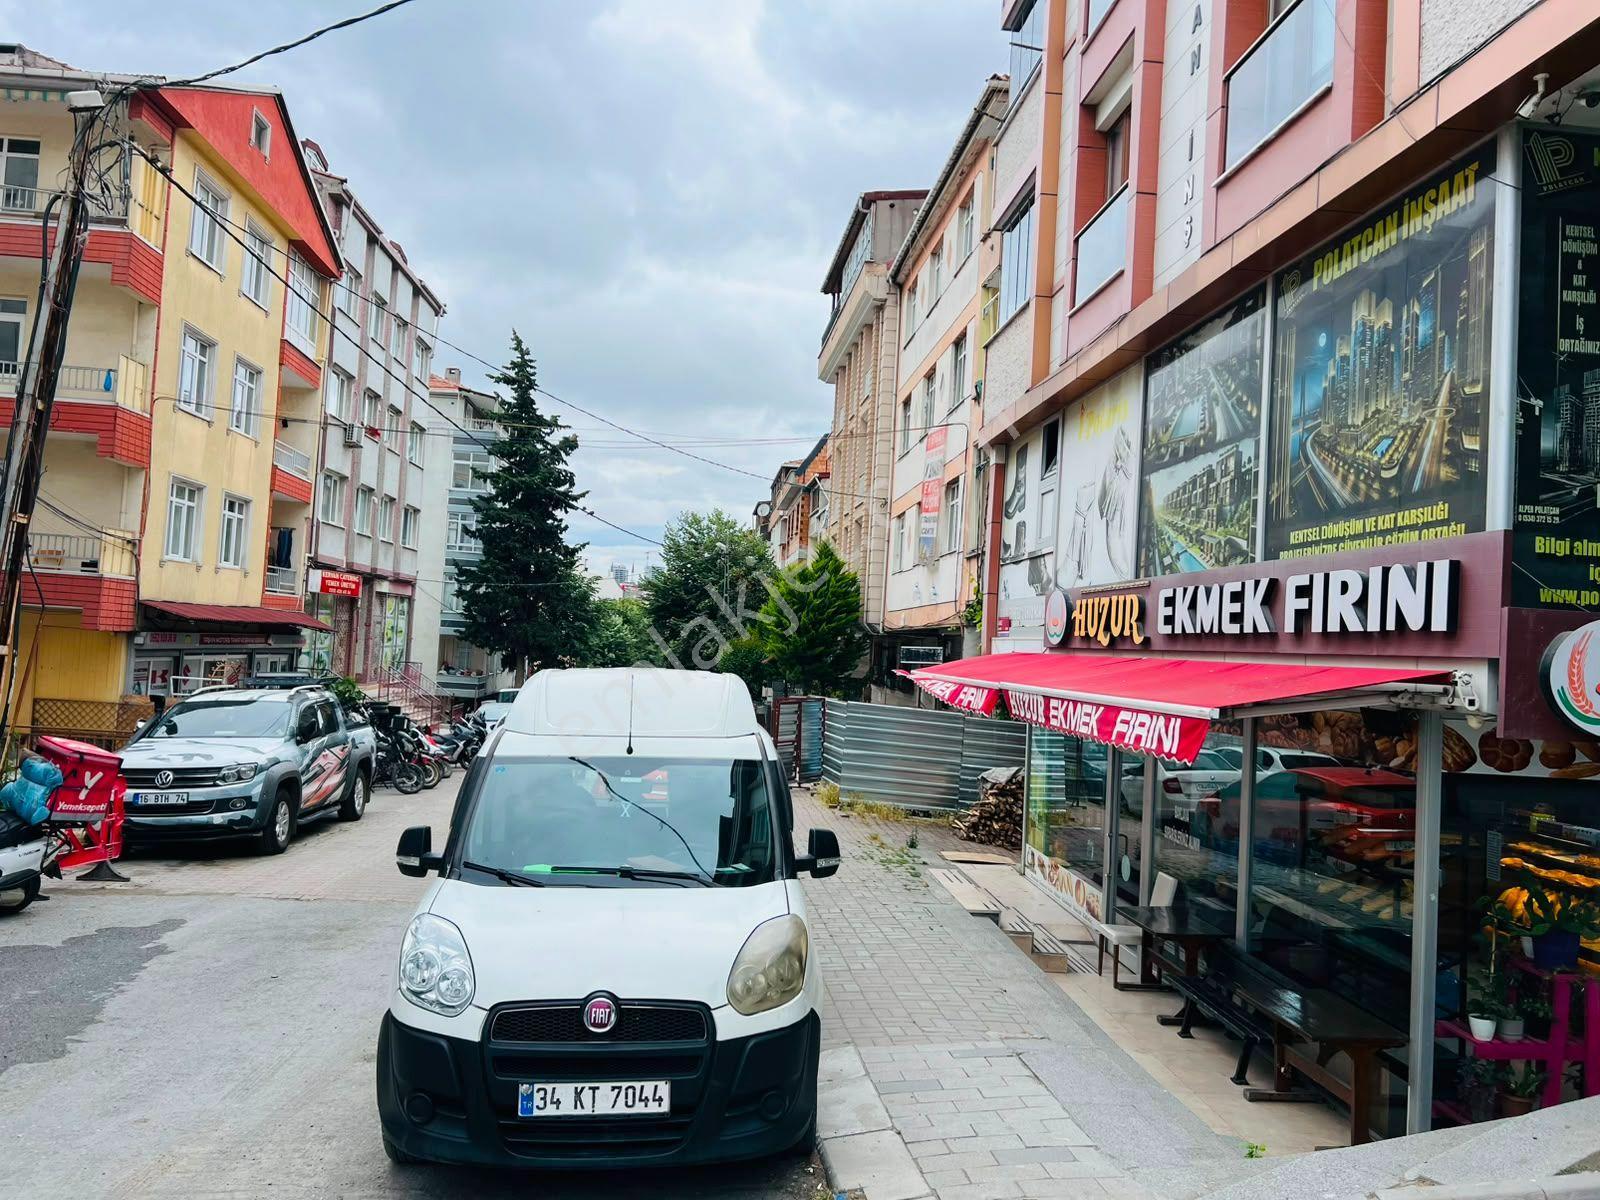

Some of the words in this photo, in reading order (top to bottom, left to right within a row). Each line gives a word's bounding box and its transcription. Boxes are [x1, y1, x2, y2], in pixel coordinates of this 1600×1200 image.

[1312, 210, 1398, 292] POLATCAN
[1401, 161, 1479, 240] İNŞAAT
[1565, 224, 1595, 238] KENTSEL
[1562, 240, 1598, 258] DÖNÜŞÜM
[1573, 274, 1587, 287] KAT
[1562, 288, 1597, 306] KARŞILIĞI
[1289, 524, 1321, 545] KENTSEL
[1321, 517, 1364, 540] DÖNÜŞÜM
[1365, 517, 1377, 533] VE
[1377, 512, 1396, 530] KAT
[1397, 501, 1448, 527] KARŞILIĞI
[1535, 536, 1570, 557] Bilgi
[1157, 577, 1274, 635] EKMEK
[1284, 558, 1453, 634] FIRINI
[1072, 594, 1145, 647] HUZUR
[1008, 690, 1046, 723] HUZUR
[1049, 698, 1104, 737] EKMEK
[1112, 710, 1181, 754] FIRINI
[57, 801, 107, 813] Yemeksepeti
[140, 795, 149, 803] 16
[154, 794, 170, 803] BTH
[175, 793, 186, 803] 74
[592, 1008, 610, 1023] FIAT
[523, 1101, 533, 1109] TR
[536, 1087, 561, 1110] 34
[573, 1087, 599, 1110] KT
[611, 1085, 664, 1109] 7044
